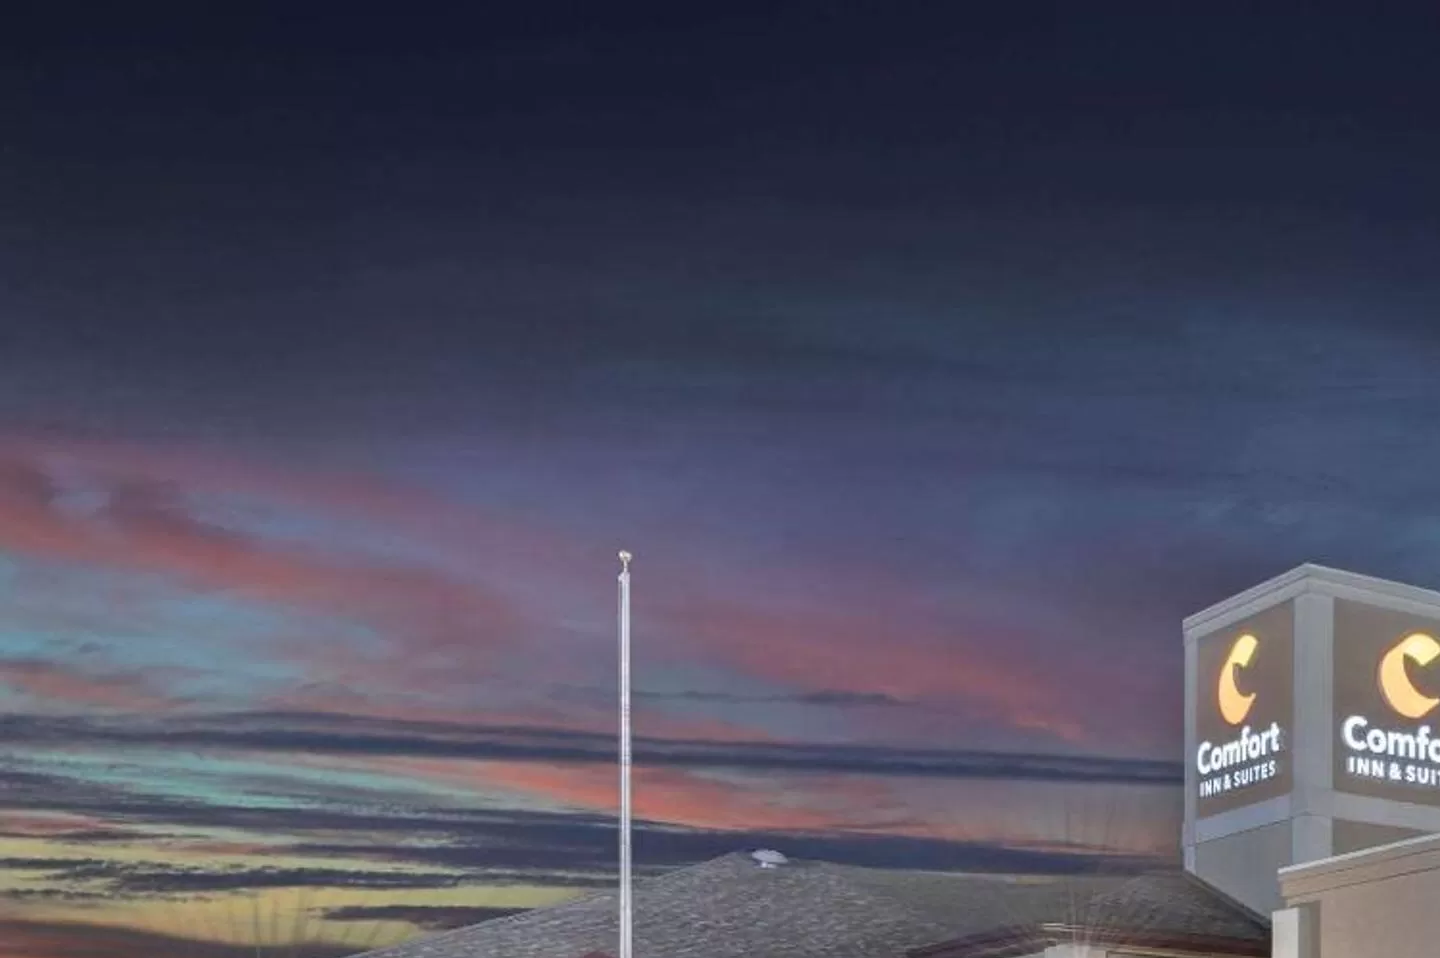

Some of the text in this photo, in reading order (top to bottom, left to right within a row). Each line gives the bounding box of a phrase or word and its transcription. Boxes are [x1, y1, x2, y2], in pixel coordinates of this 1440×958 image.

[1197, 722, 1280, 774] Comfort
[1200, 760, 1276, 798] INN & SUITES
[1347, 757, 1384, 779] INN
[1389, 764, 1403, 782] &
